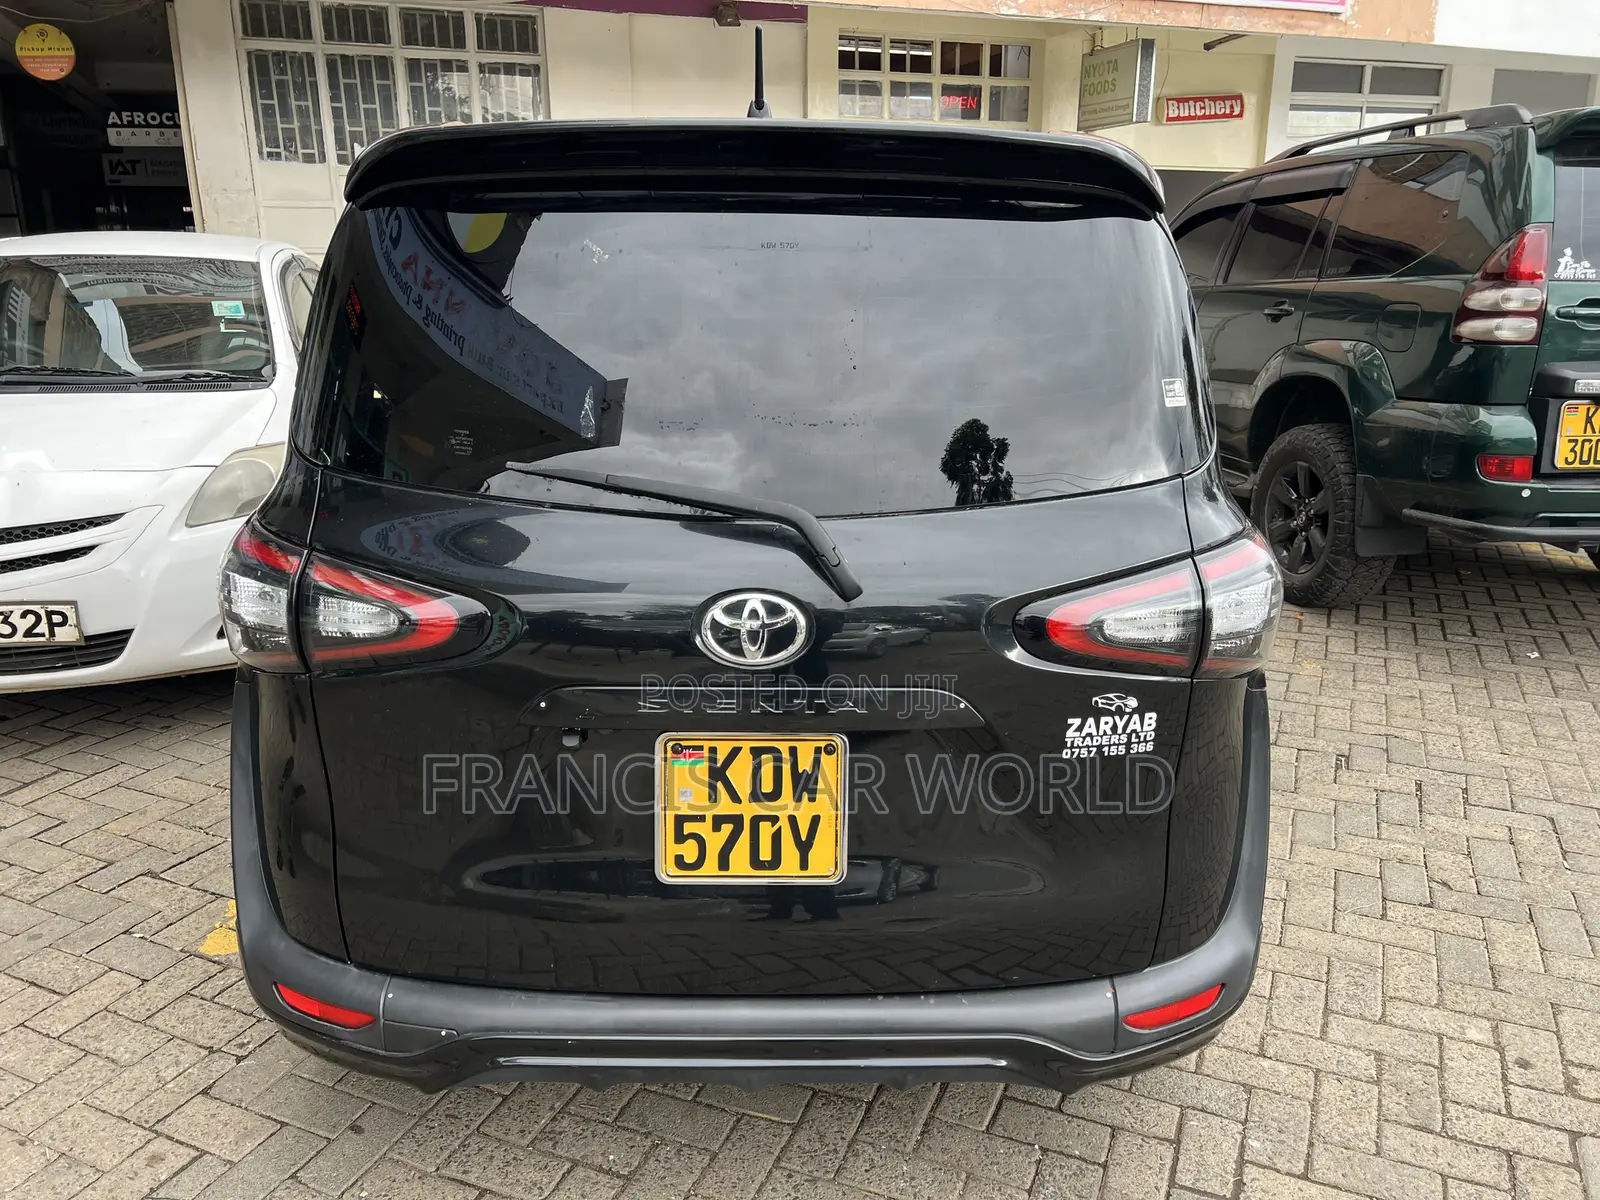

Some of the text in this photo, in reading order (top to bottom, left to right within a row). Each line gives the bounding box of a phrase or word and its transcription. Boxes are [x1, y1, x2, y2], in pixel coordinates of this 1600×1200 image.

[1084, 58, 1119, 80] NYOTA
[1083, 77, 1117, 98] FOODS
[940, 95, 978, 110] OPEN
[1167, 97, 1242, 118] Butchery
[1065, 712, 1158, 738] ZARYAB
[1065, 731, 1155, 748] TRADERS LTD
[1062, 742, 1154, 759] 0757 155 366
[707, 745, 823, 805] KDW
[673, 813, 821, 872] 570Y
